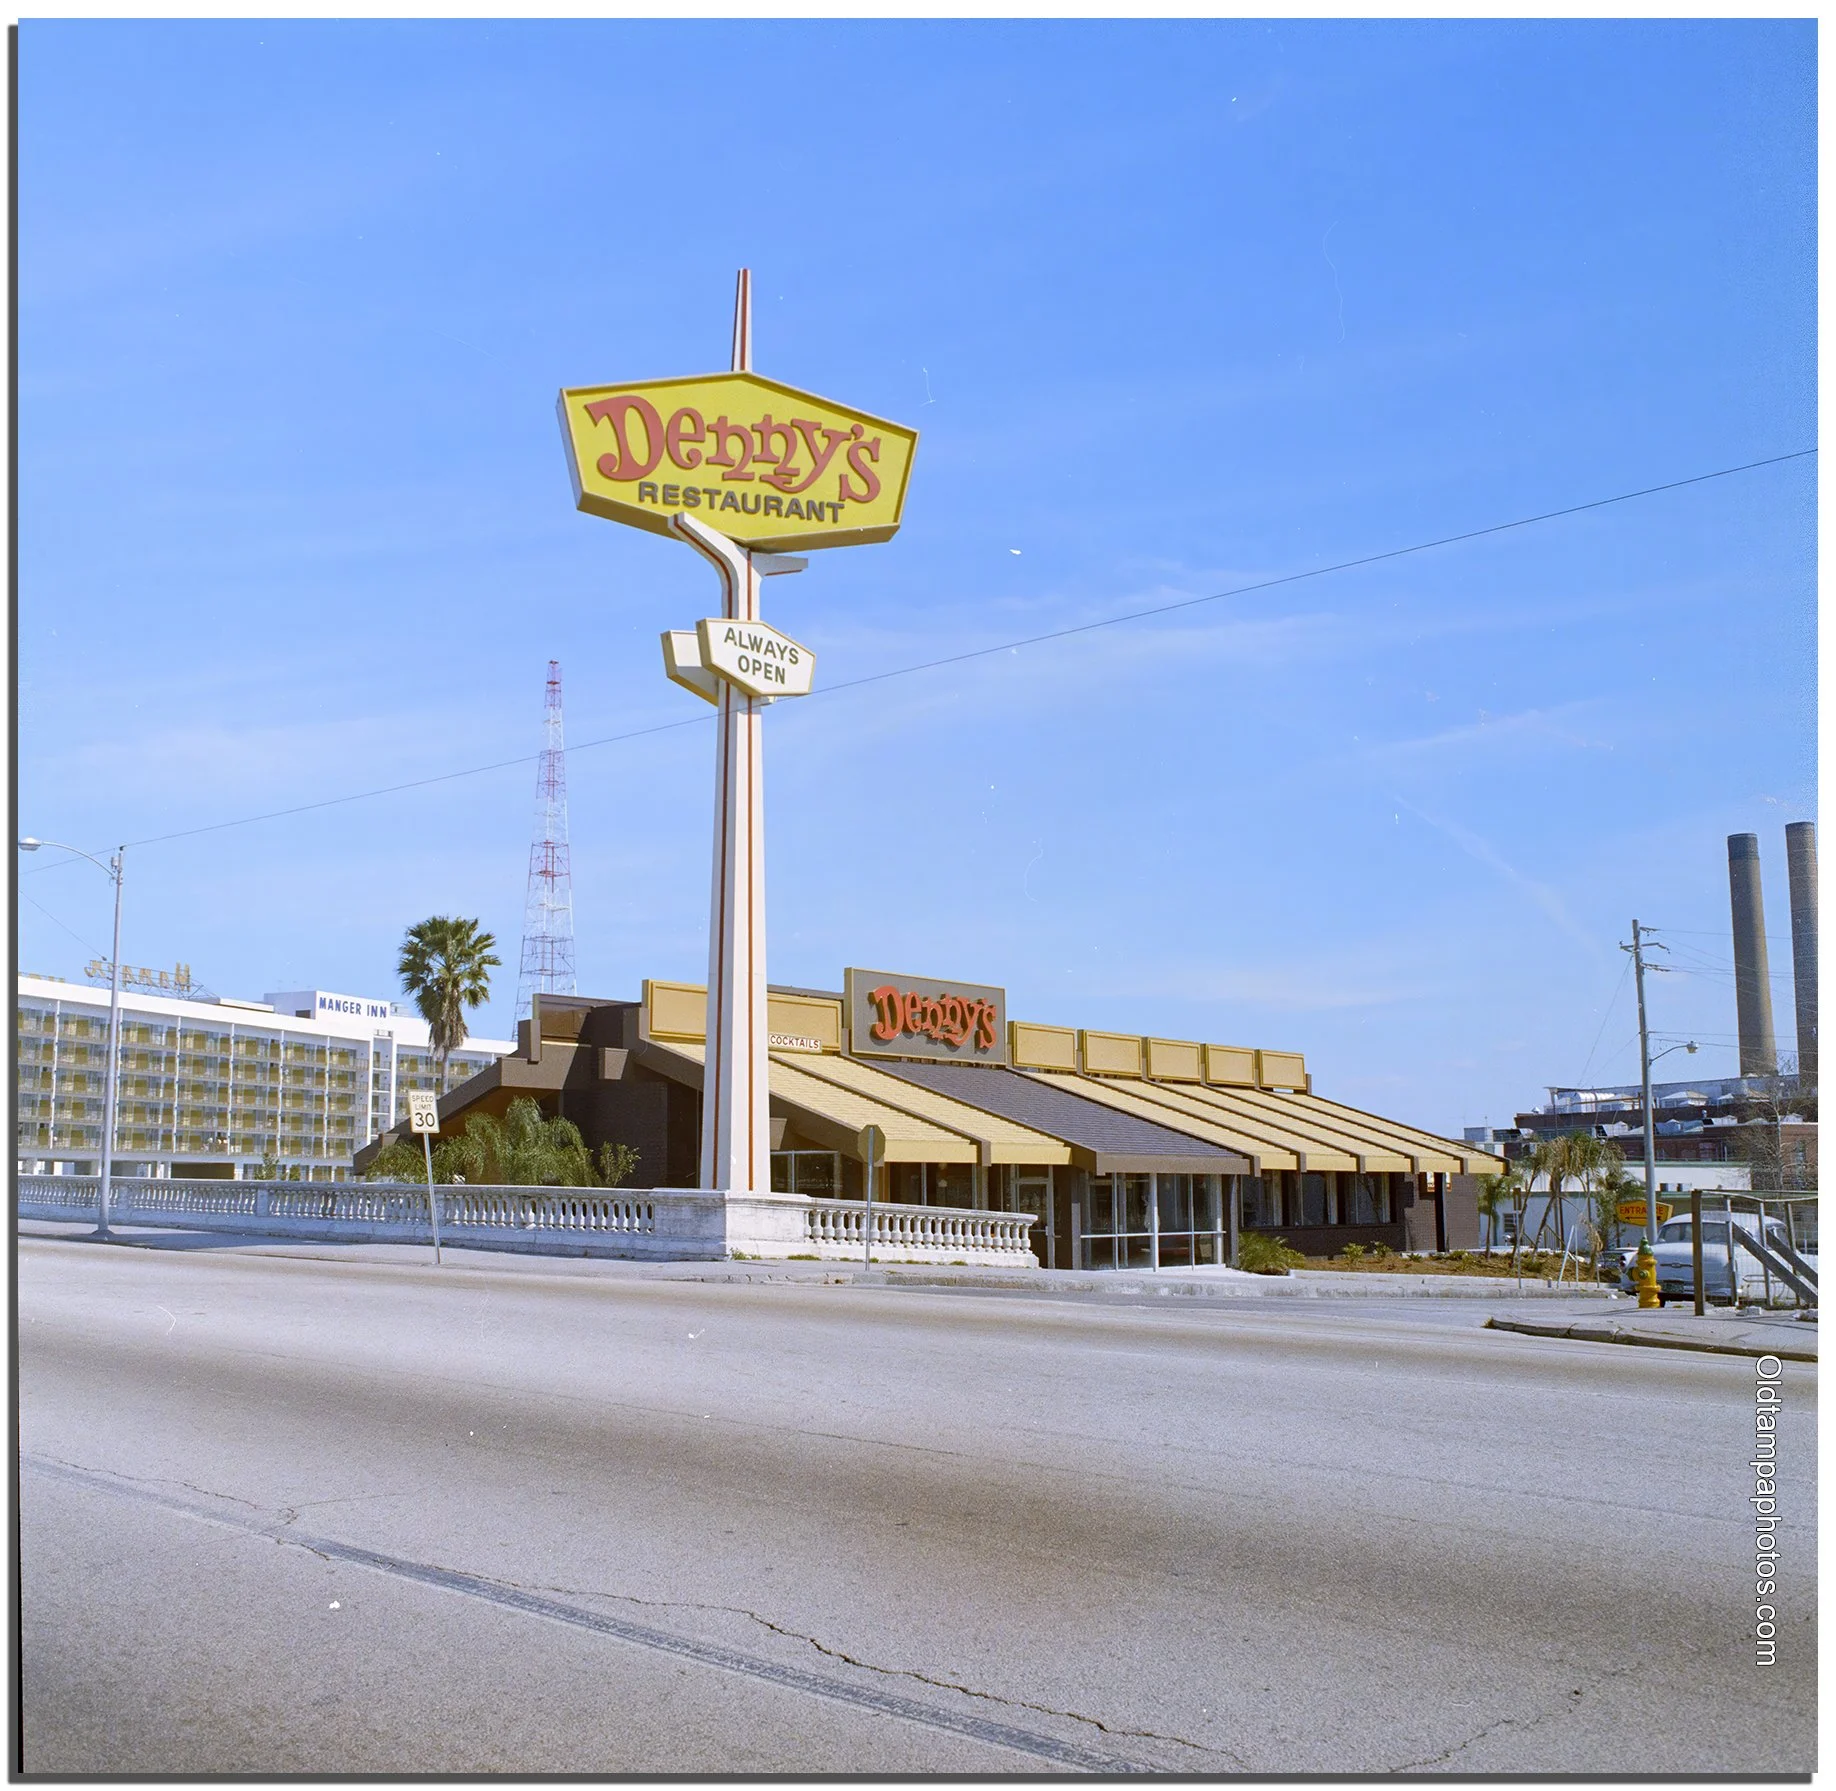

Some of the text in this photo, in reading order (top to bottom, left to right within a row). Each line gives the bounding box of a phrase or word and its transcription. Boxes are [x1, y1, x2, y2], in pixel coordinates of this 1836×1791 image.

[584, 395, 881, 504] Denny's
[638, 481, 845, 524] RESTAURANT
[723, 627, 800, 666] ALWAYS
[737, 655, 786, 685] OPEN
[319, 996, 387, 1019] MANGER INN
[872, 985, 997, 1049] Denny's
[770, 1034, 819, 1049] COCKTAILS
[411, 1094, 434, 1103] SPEED
[415, 1112, 435, 1127] 30
[1619, 1205, 1665, 1216] ENTRAE
